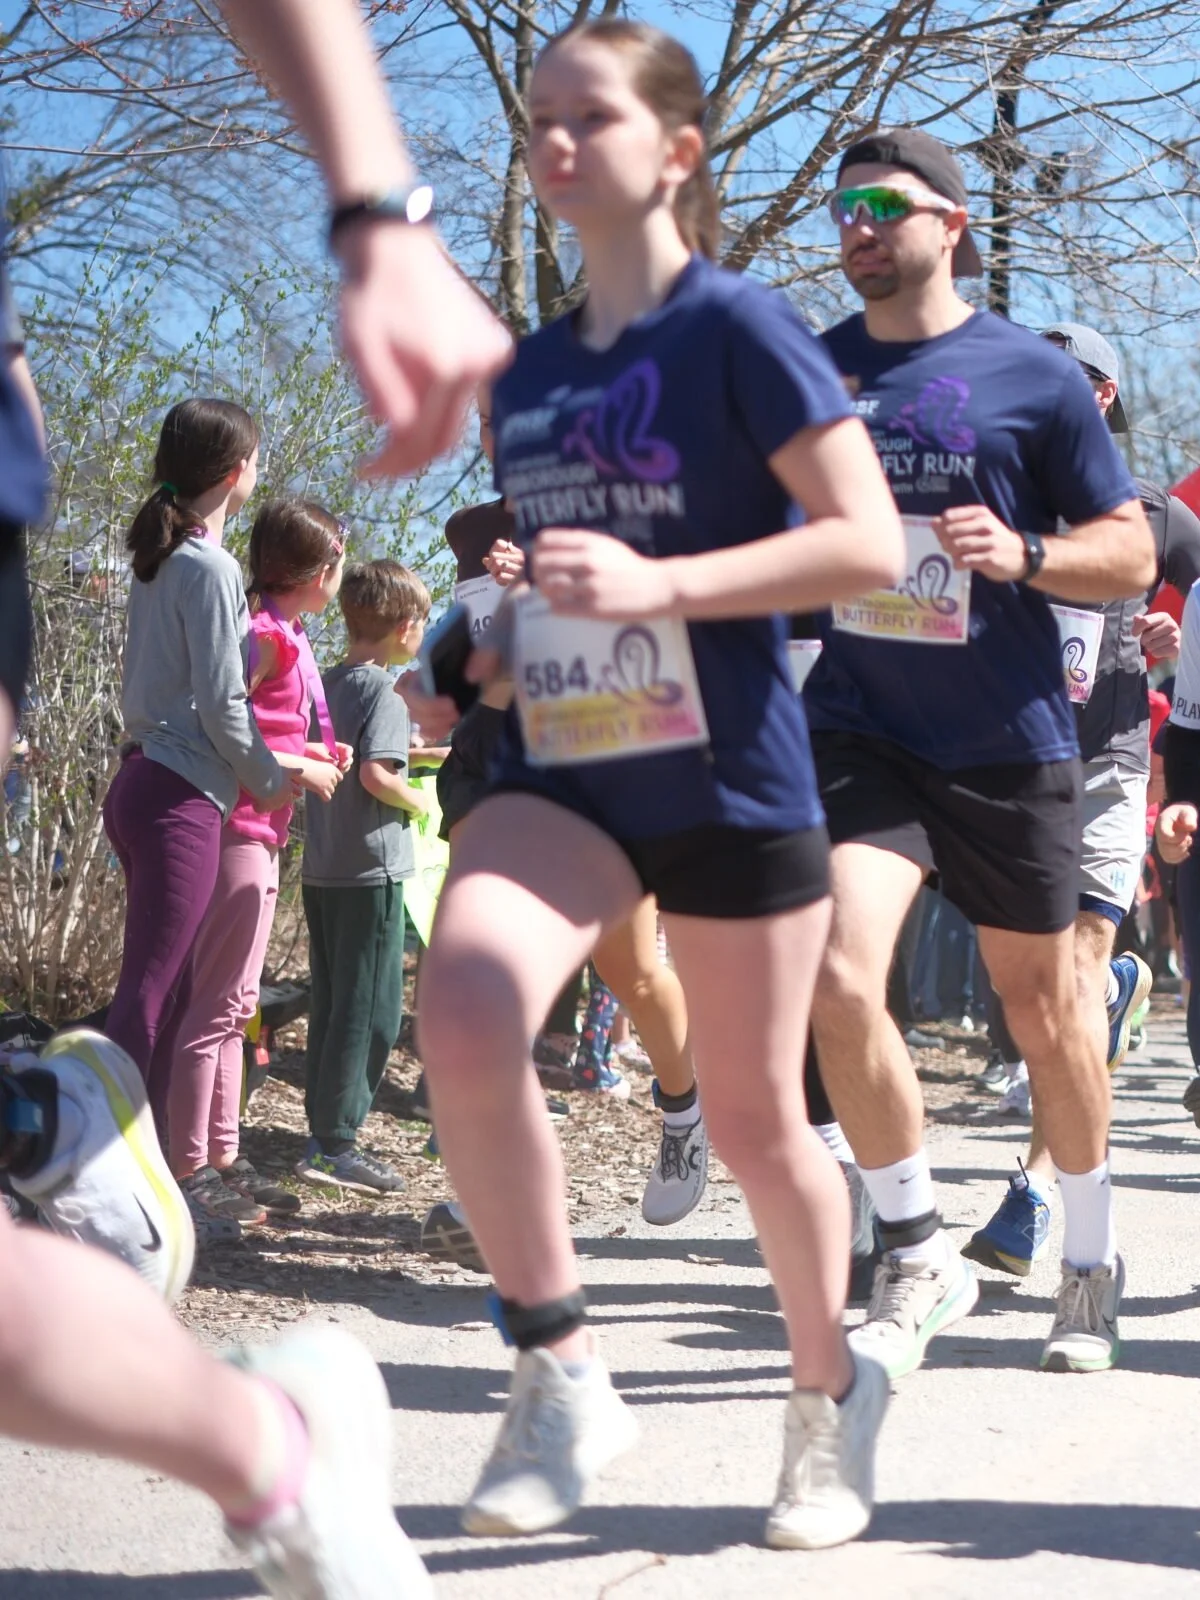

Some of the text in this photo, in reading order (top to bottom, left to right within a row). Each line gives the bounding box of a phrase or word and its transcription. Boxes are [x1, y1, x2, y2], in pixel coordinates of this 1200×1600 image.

[923, 452, 976, 477] RUN
[610, 482, 685, 520] RUN
[842, 606, 916, 629] BUTTERFLY
[525, 654, 590, 698] 584
